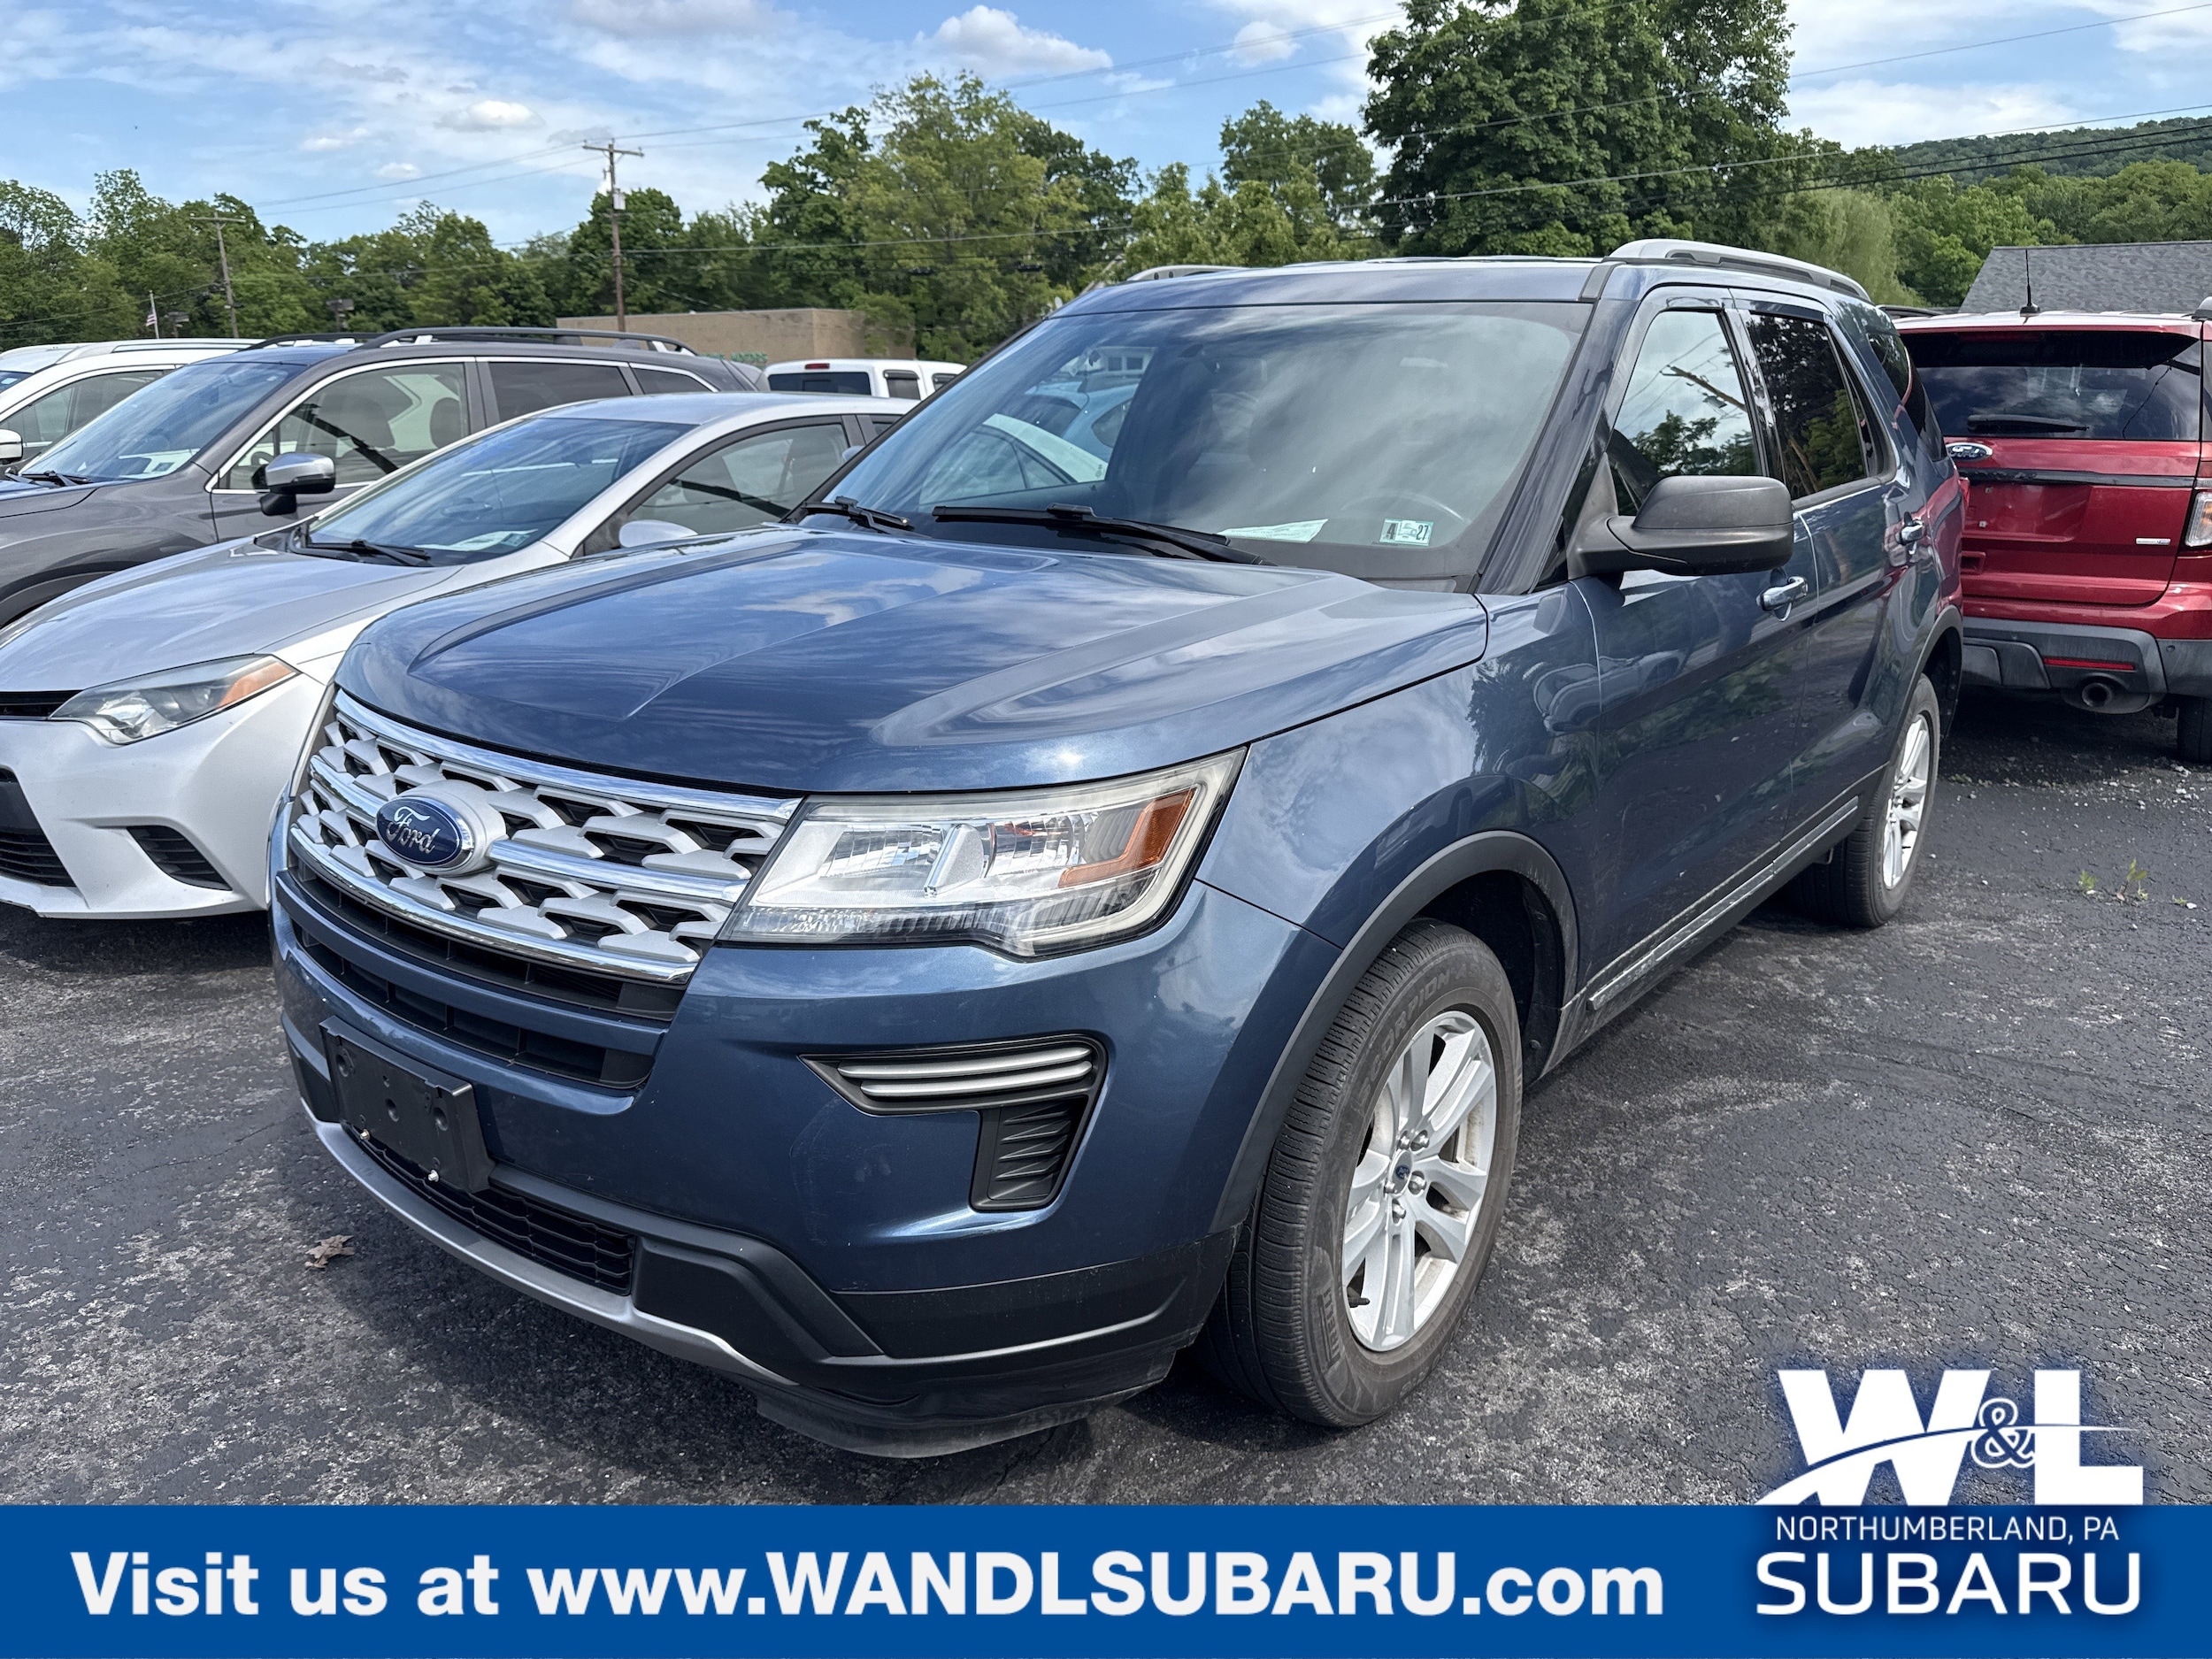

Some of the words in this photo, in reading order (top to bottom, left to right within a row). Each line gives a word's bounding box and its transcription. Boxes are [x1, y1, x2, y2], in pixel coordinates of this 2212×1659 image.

[1386, 522, 1397, 540] 4
[1416, 525, 1429, 541] 27
[386, 806, 441, 854] Ford
[1317, 1287, 1341, 1370] PIRELLI
